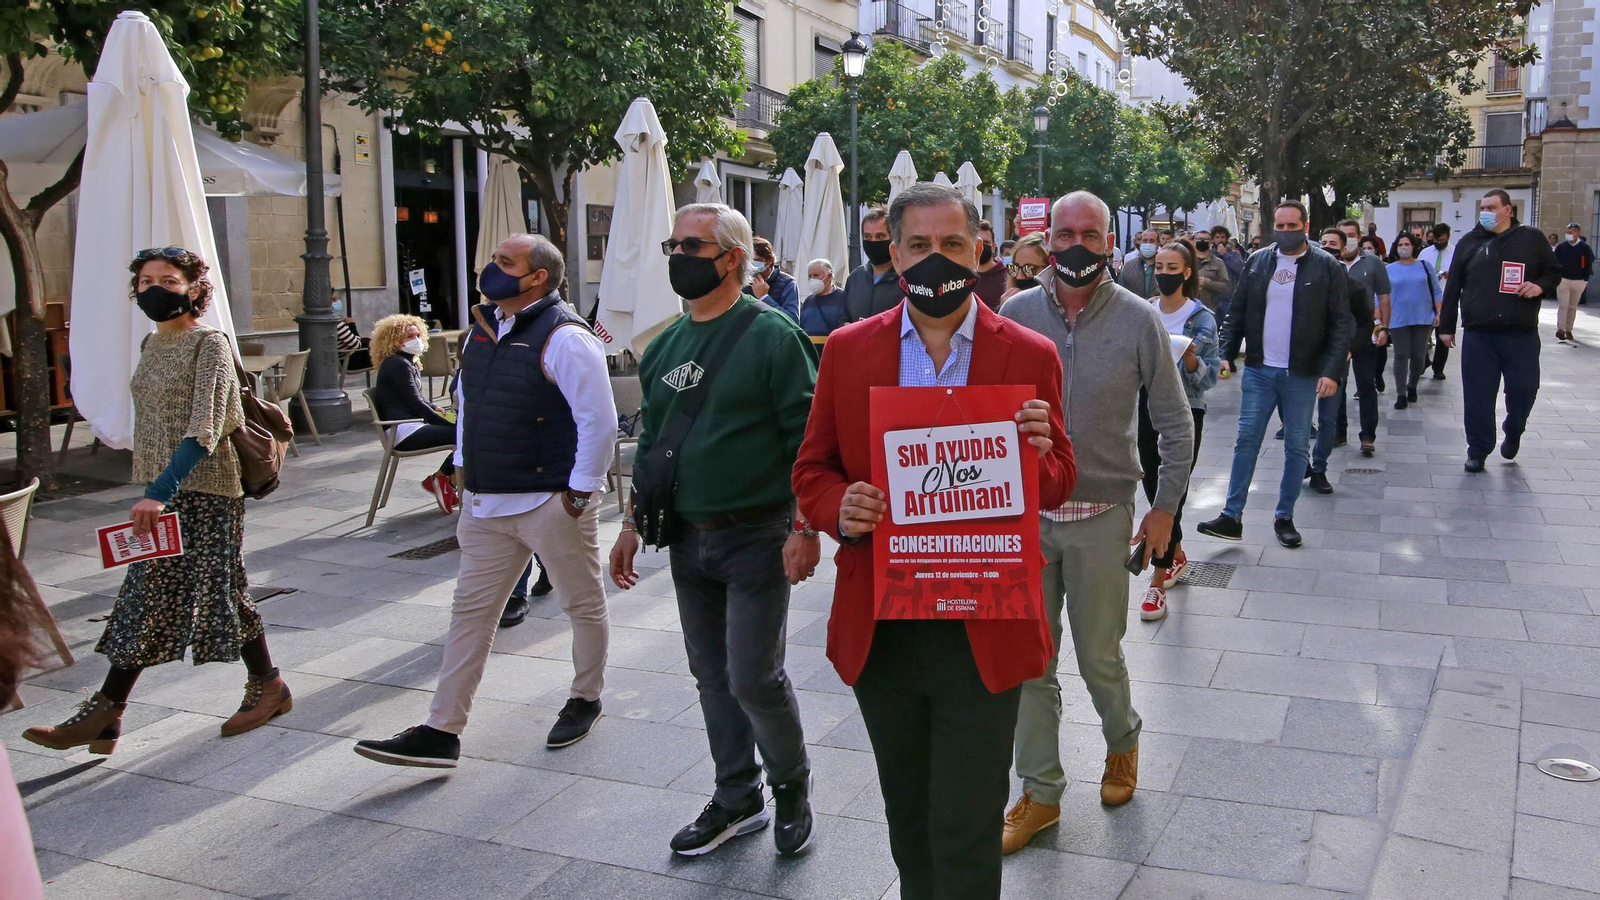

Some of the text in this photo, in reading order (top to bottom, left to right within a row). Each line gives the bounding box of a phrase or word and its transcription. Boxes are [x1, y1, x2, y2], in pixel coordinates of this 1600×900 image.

[1056, 262, 1076, 278] vuelve
[908, 284, 934, 298] vuelve
[898, 436, 1008, 467] SIN AYUDAS
[922, 456, 982, 494] Nos
[904, 482, 1012, 516] Arruinan!
[889, 534, 1022, 553] CONCENTRACIONES
